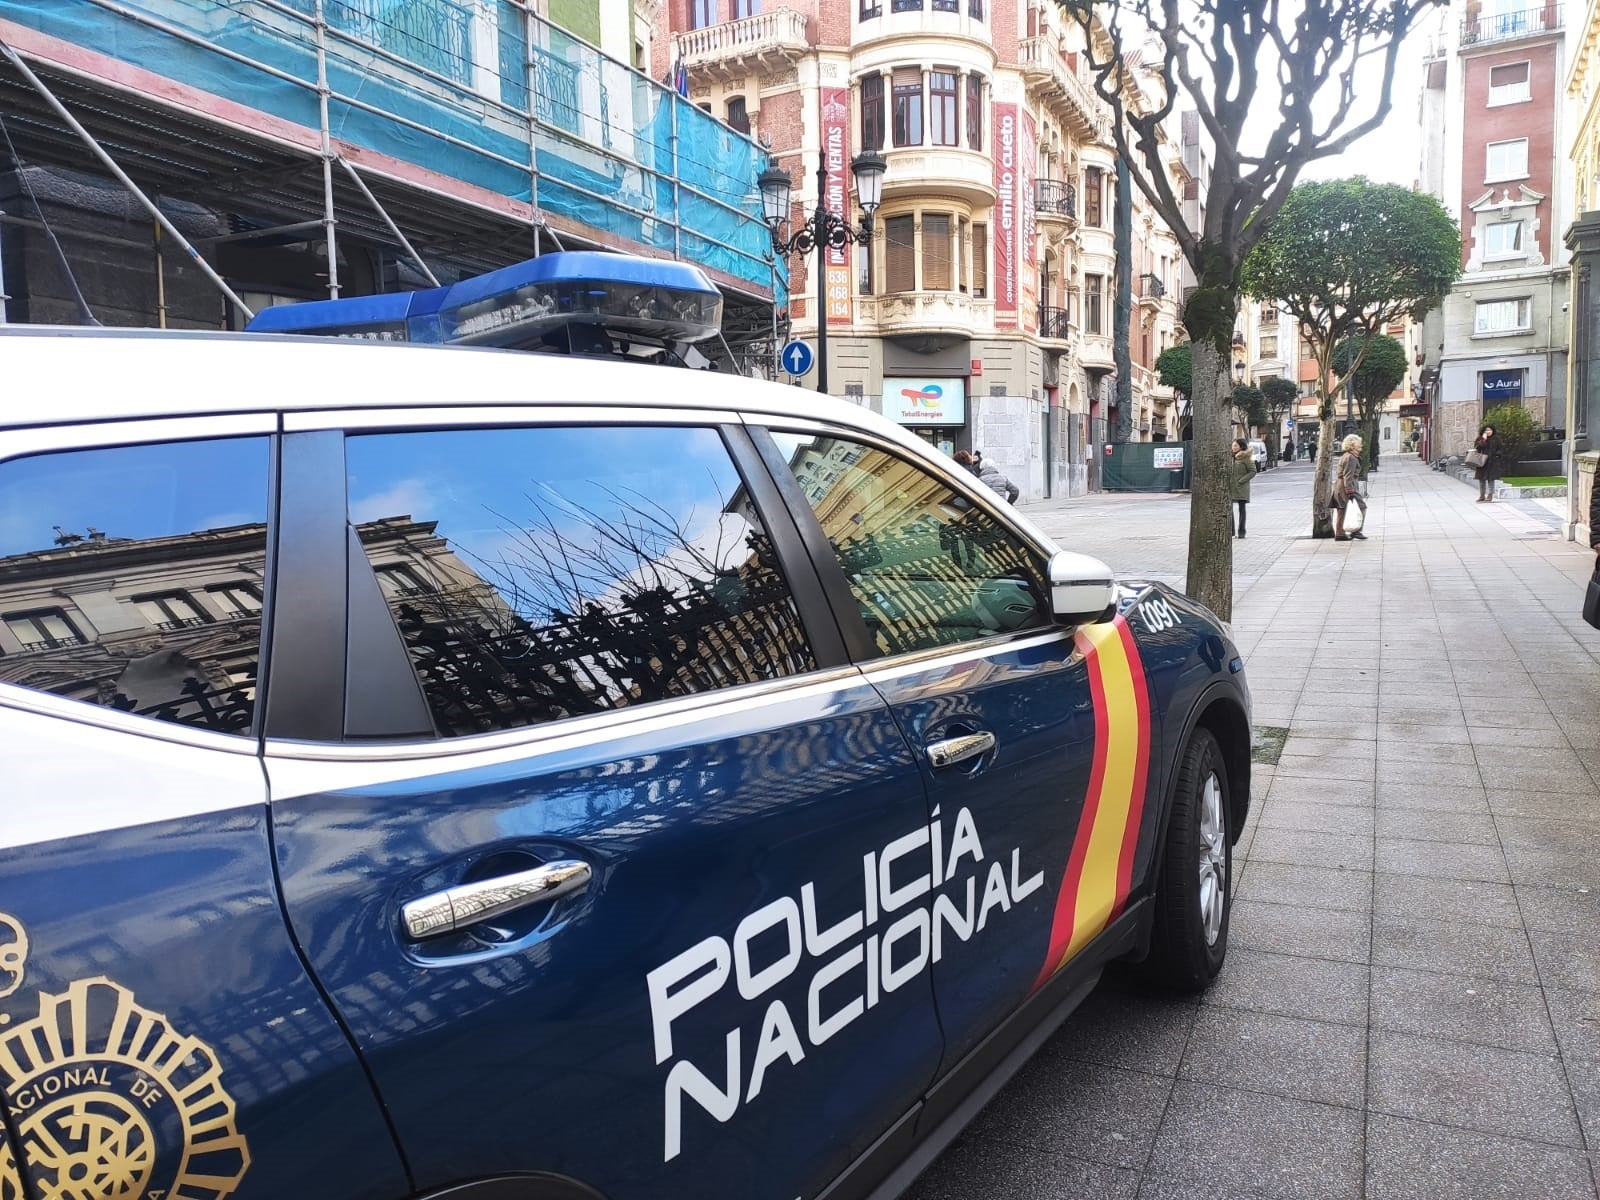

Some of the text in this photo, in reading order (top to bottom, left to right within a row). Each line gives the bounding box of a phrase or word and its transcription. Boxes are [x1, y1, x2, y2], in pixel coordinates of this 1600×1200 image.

[829, 126, 842, 172] VENTAS
[1001, 115, 1013, 168] cueto
[829, 174, 843, 183] Y
[999, 172, 1013, 229] emilio
[1495, 379, 1521, 387] Aural
[902, 410, 943, 419] TotalEnergies
[1144, 598, 1182, 631] 091
[646, 803, 985, 1065] POLICÍA
[664, 847, 1045, 1163] NACIONAL
[129, 1078, 163, 1109] DE
